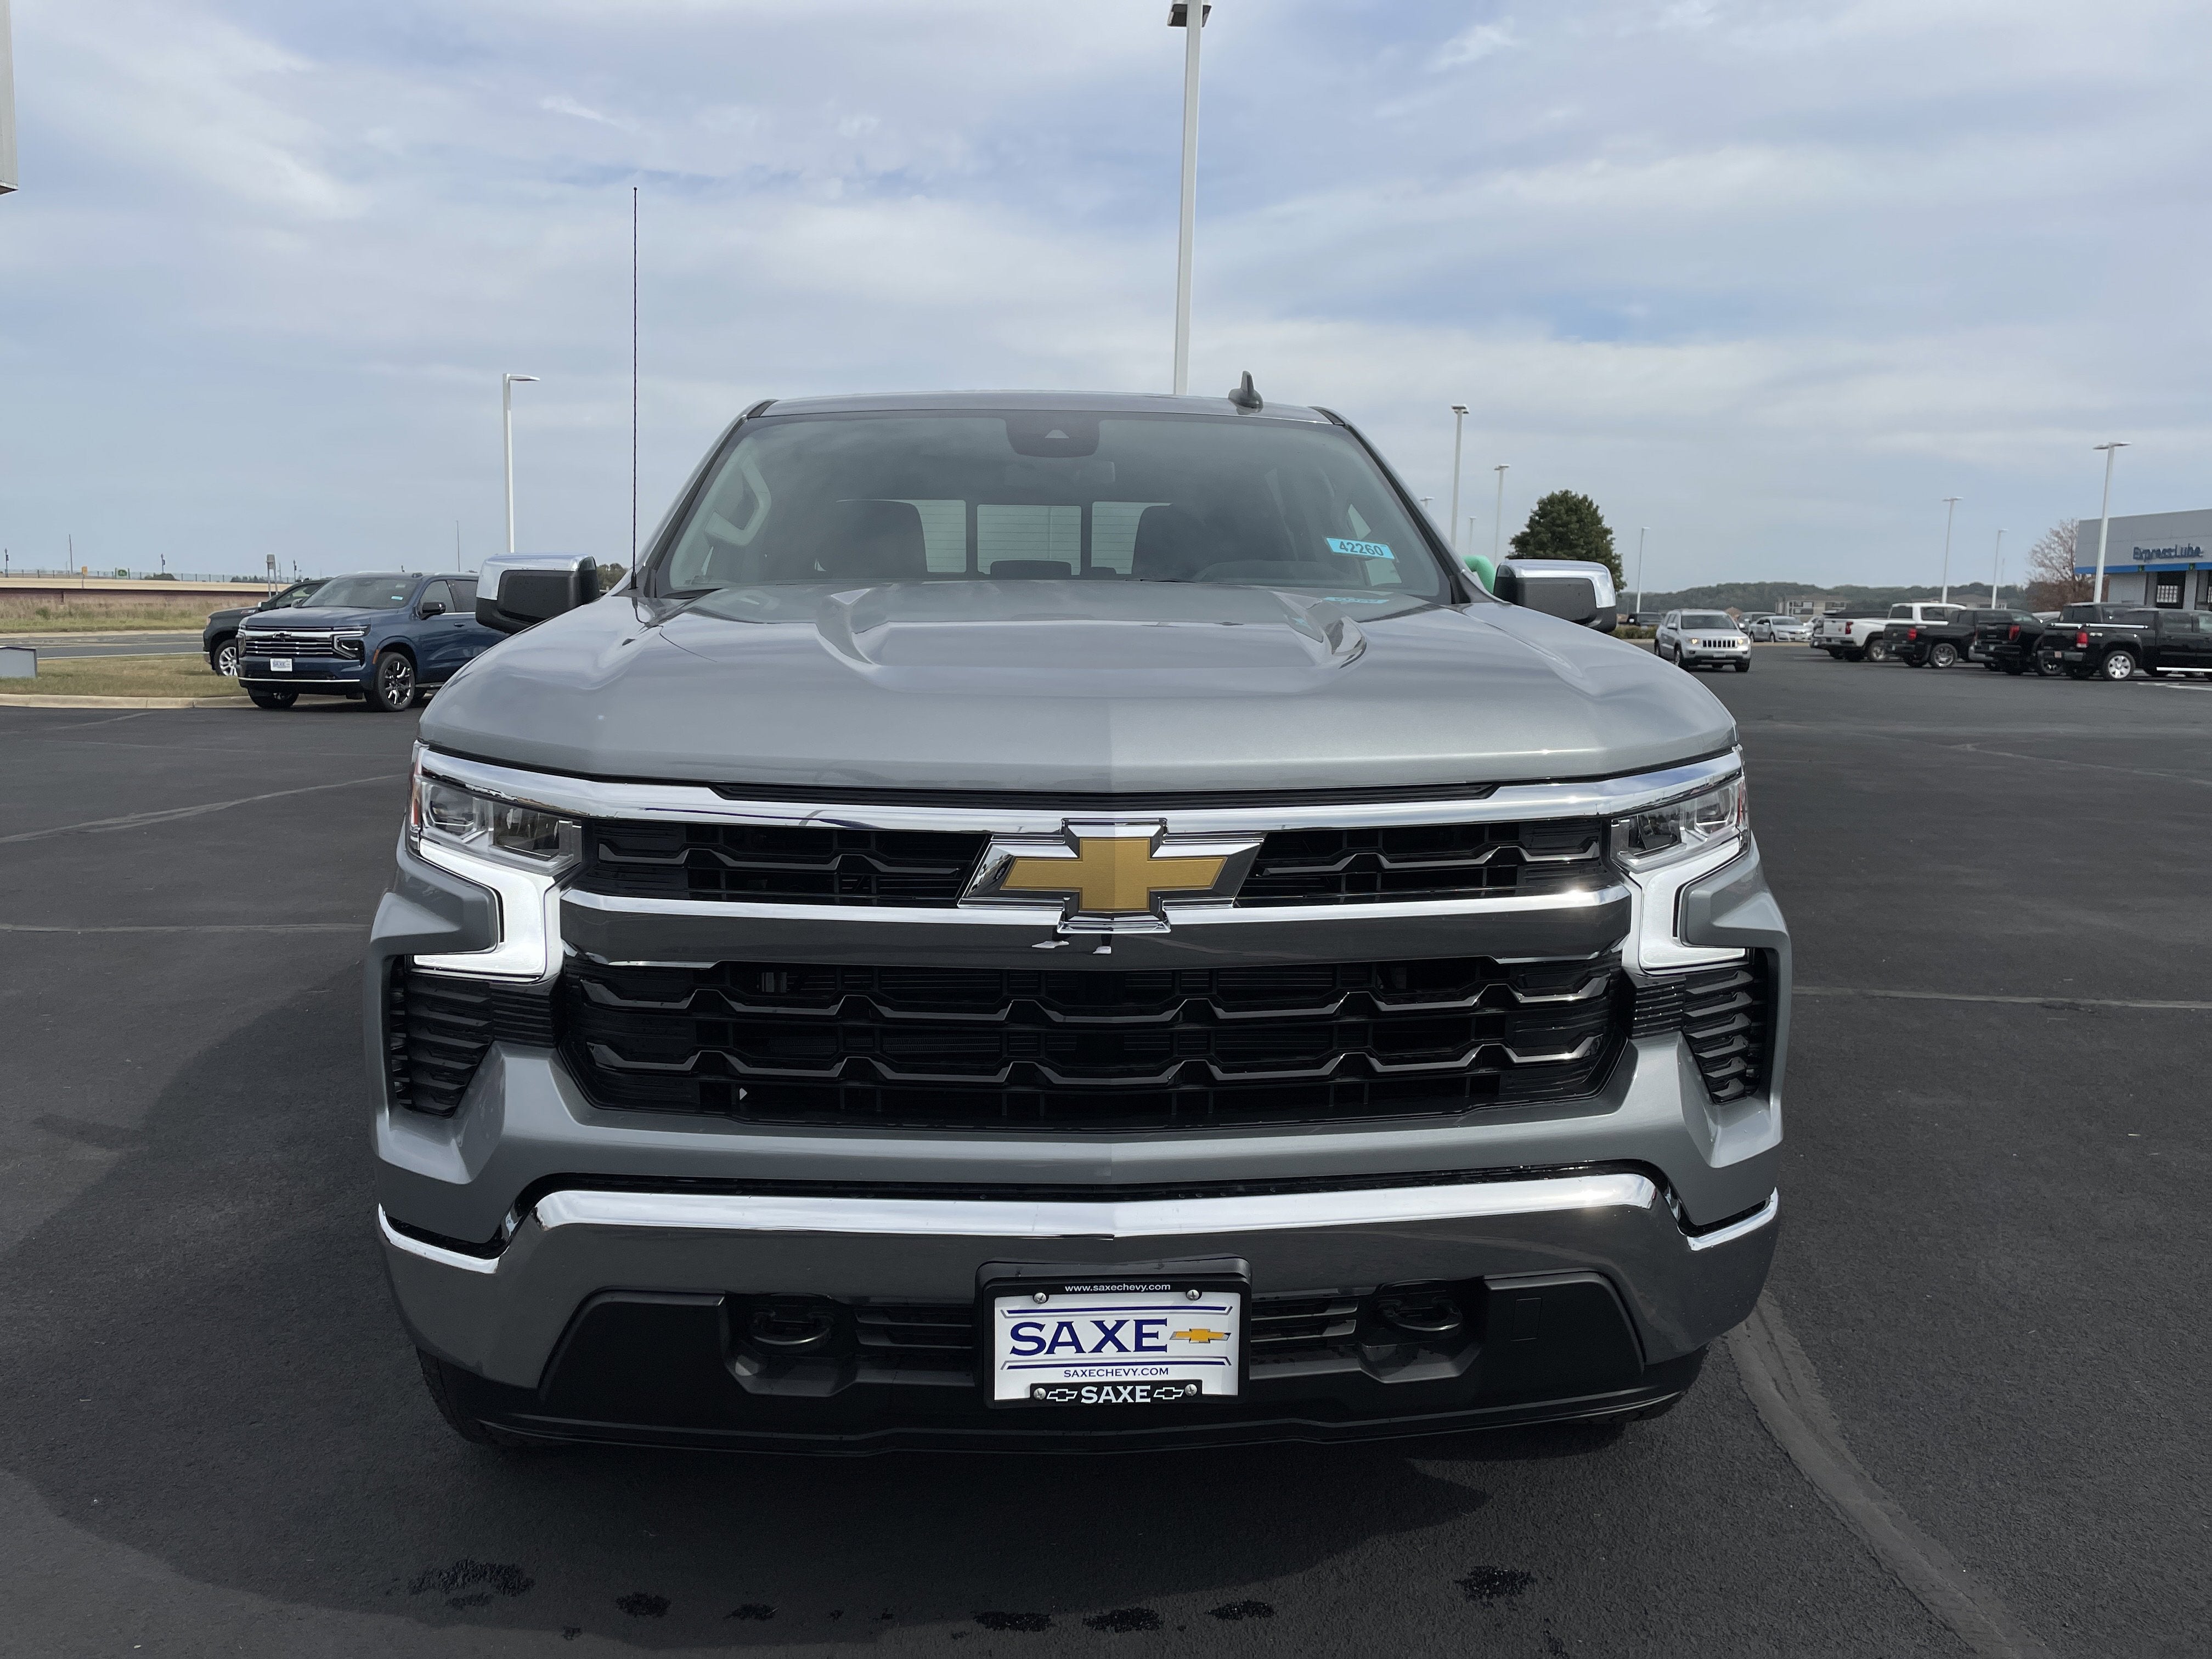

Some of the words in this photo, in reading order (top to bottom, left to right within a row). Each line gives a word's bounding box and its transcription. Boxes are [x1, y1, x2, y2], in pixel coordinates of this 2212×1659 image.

[1339, 541, 1384, 556] 42260
[1065, 1283, 1171, 1292] www.saxechevy.com
[1009, 1318, 1167, 1356] SAXE
[1064, 1368, 1169, 1378] SAXECHEVY.COM
[1081, 1385, 1150, 1403] SAXE
